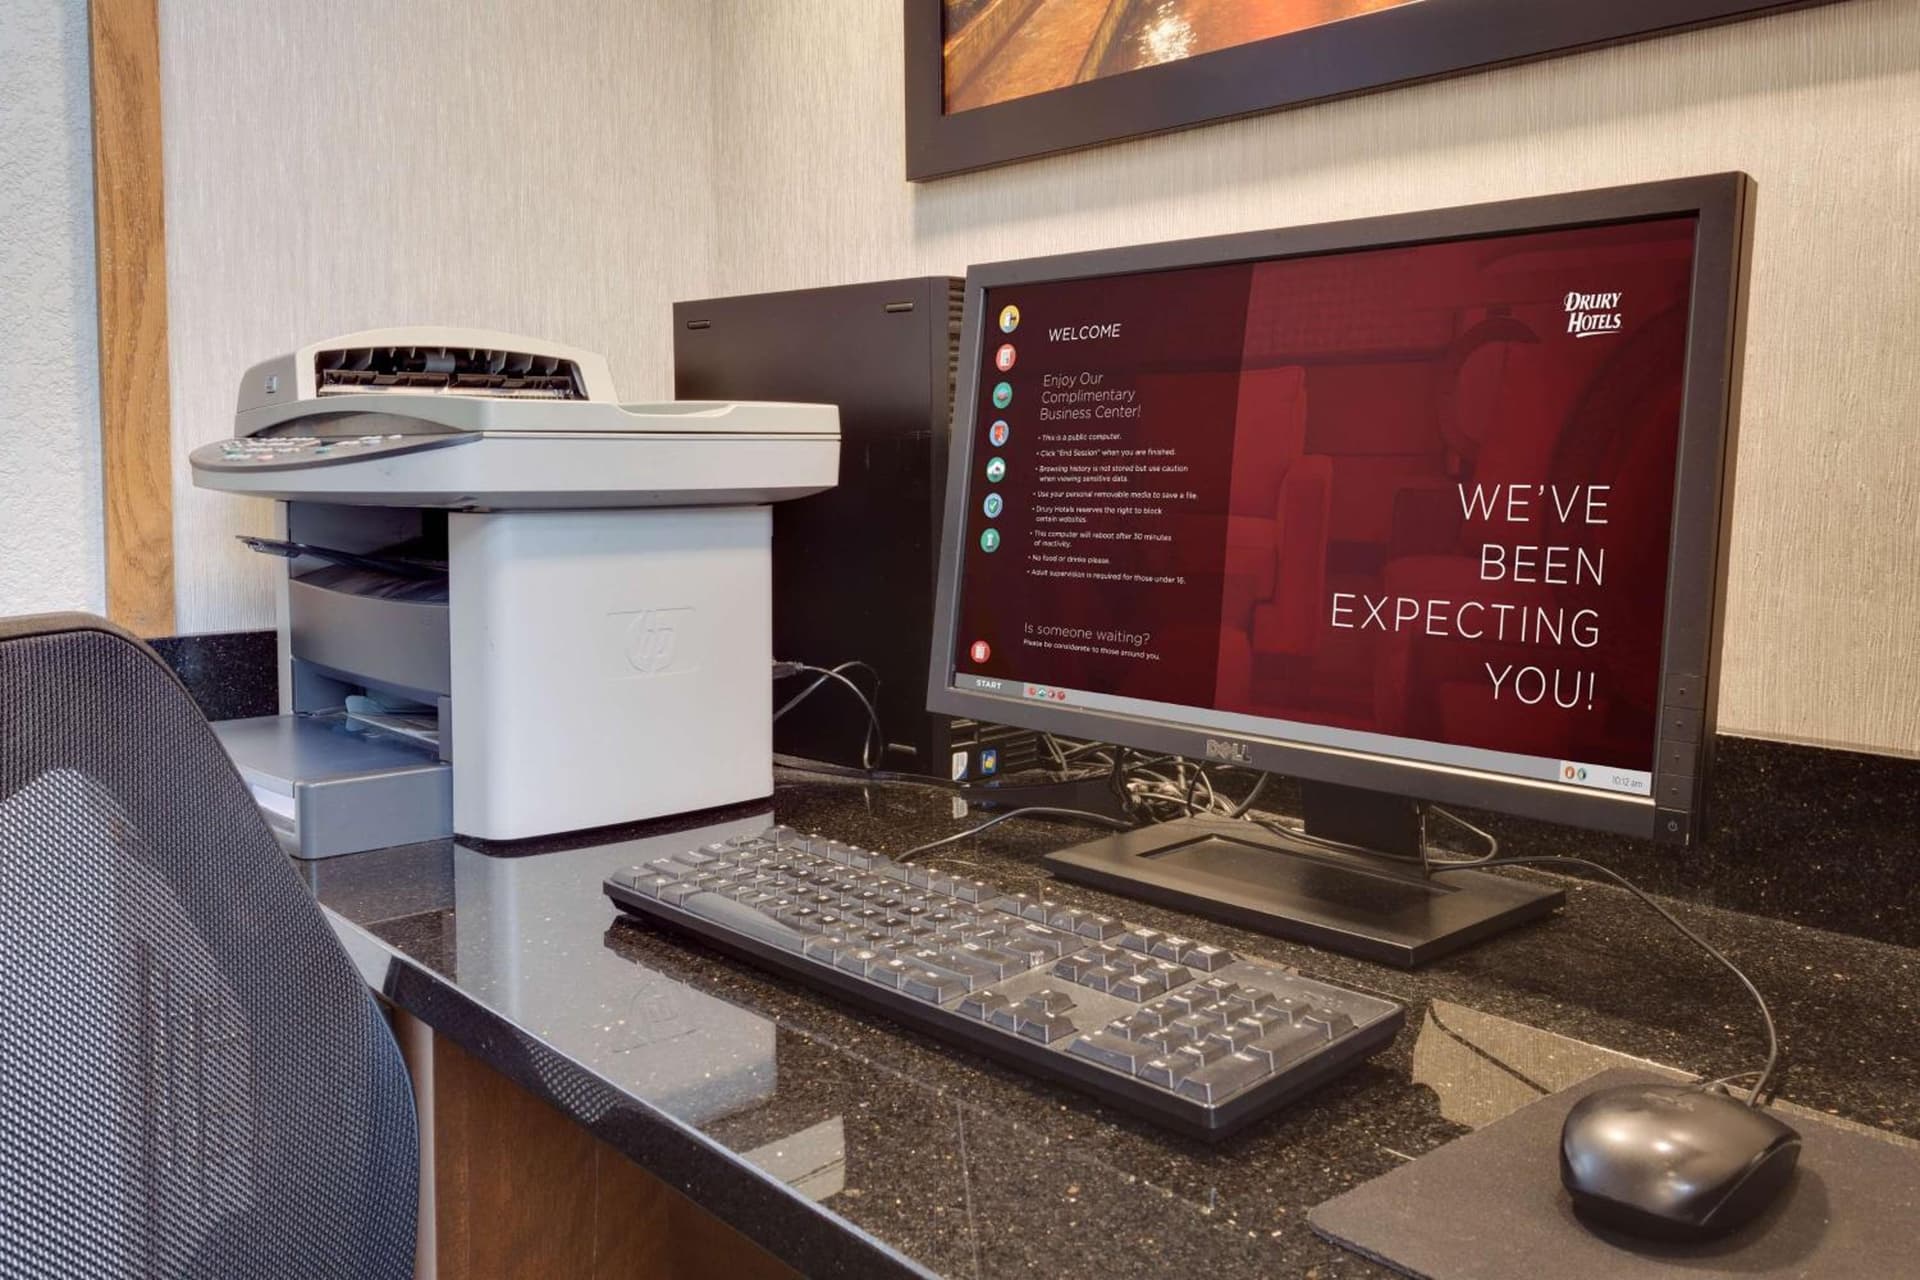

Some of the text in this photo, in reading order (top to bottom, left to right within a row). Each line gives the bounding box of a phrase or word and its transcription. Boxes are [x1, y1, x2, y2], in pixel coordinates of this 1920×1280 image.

[1564, 292, 1622, 311] DRURY
[1568, 312, 1621, 332] HOTELS
[1048, 323, 1122, 342] WELCOME
[1043, 372, 1103, 388] Enjoy Our
[1041, 390, 1136, 404] Complimentary
[1040, 405, 1141, 421] Business Center!
[1039, 465, 1068, 473] Browsing
[1117, 507, 1133, 515] right
[1458, 483, 1610, 524] WE'VE
[1048, 531, 1078, 539] computer
[1480, 544, 1604, 586] BEEN
[1050, 570, 1085, 578] supervision
[1093, 572, 1121, 580] required
[1134, 574, 1152, 582] those
[1332, 592, 1599, 648] EXPECTING
[1024, 622, 1150, 647] Is someone waiting?
[1024, 639, 1042, 648] Please
[1054, 641, 1090, 653] considerate
[1092, 645, 1099, 653] to
[1101, 646, 1119, 656] those
[1121, 648, 1145, 659] around
[976, 679, 1002, 689] START
[1485, 662, 1594, 710] YOU!
